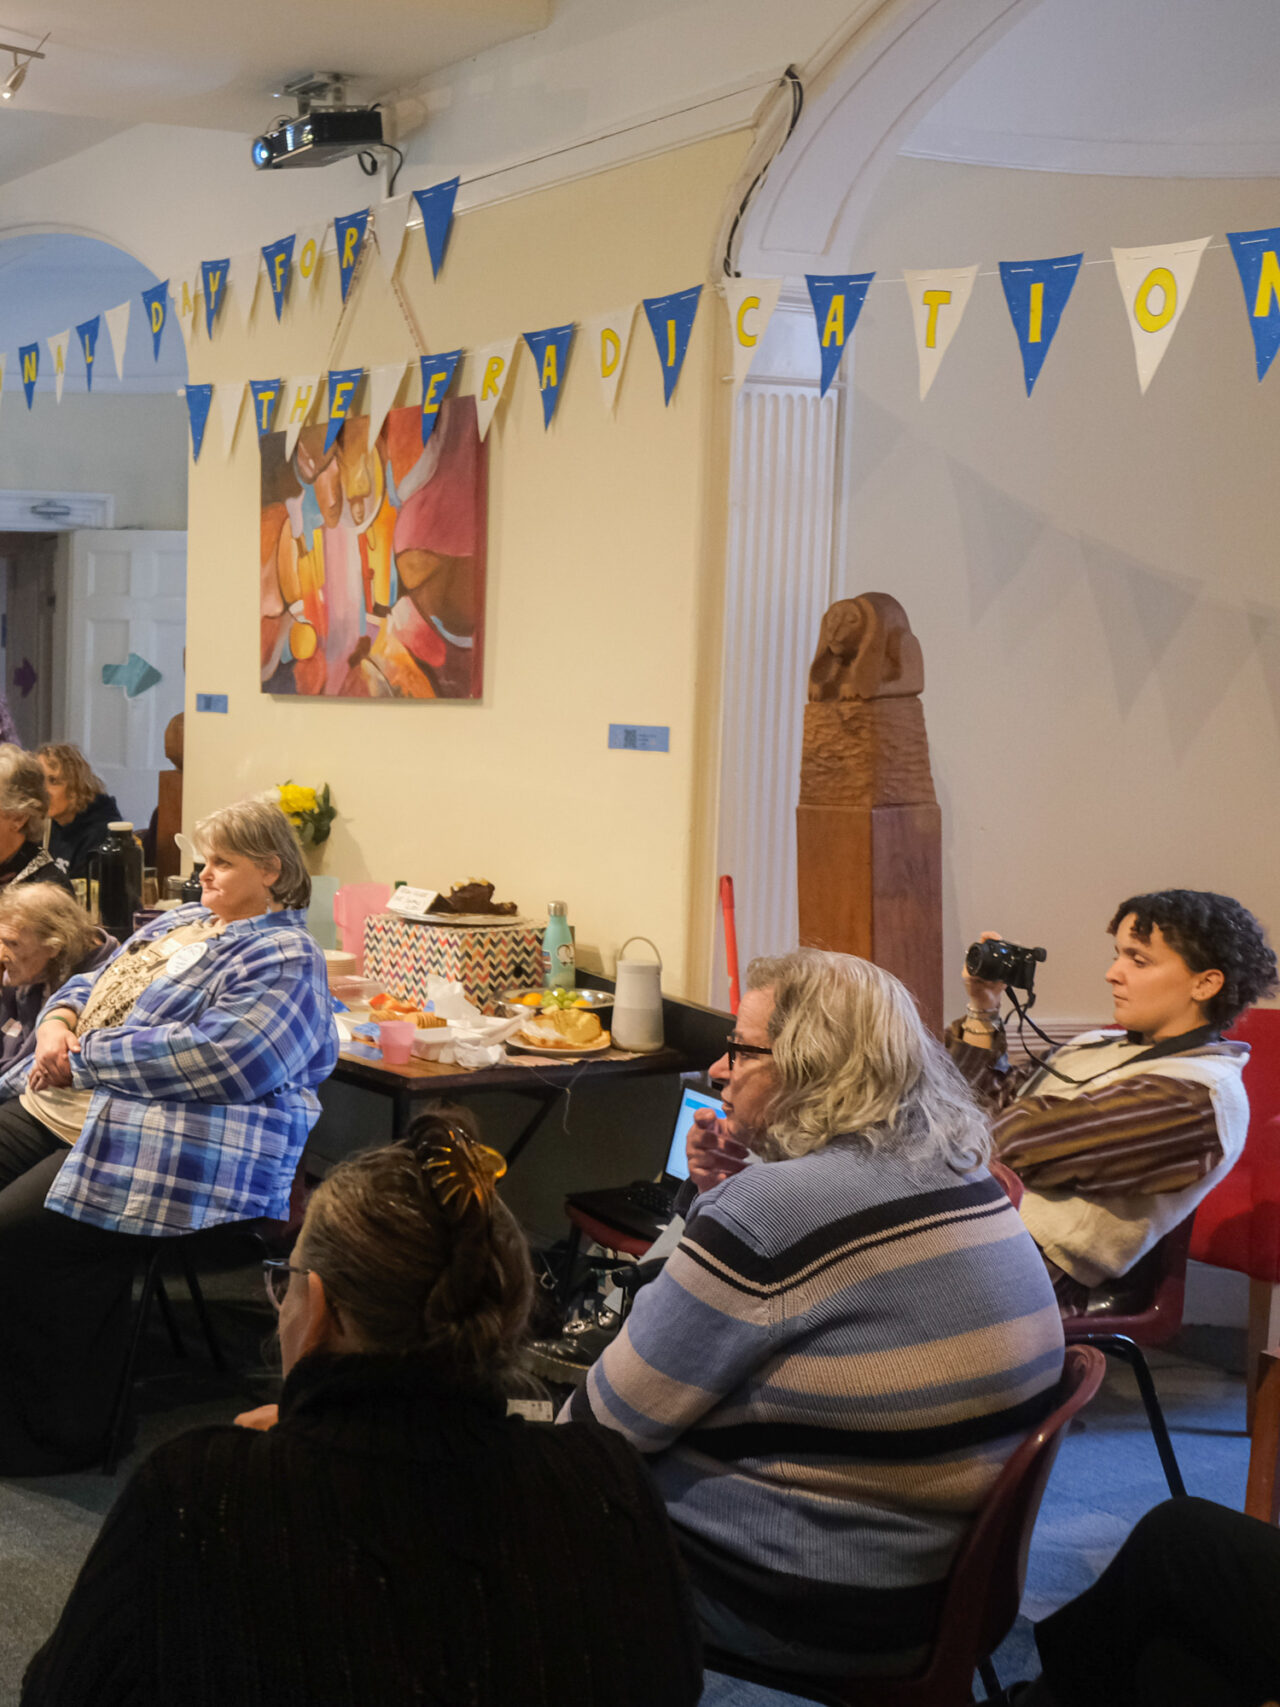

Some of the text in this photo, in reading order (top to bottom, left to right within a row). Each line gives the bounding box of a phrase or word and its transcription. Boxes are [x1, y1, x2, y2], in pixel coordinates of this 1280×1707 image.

[150, 269, 221, 333] DAY
[272, 226, 359, 292] FOR
[258, 381, 355, 430] THE
